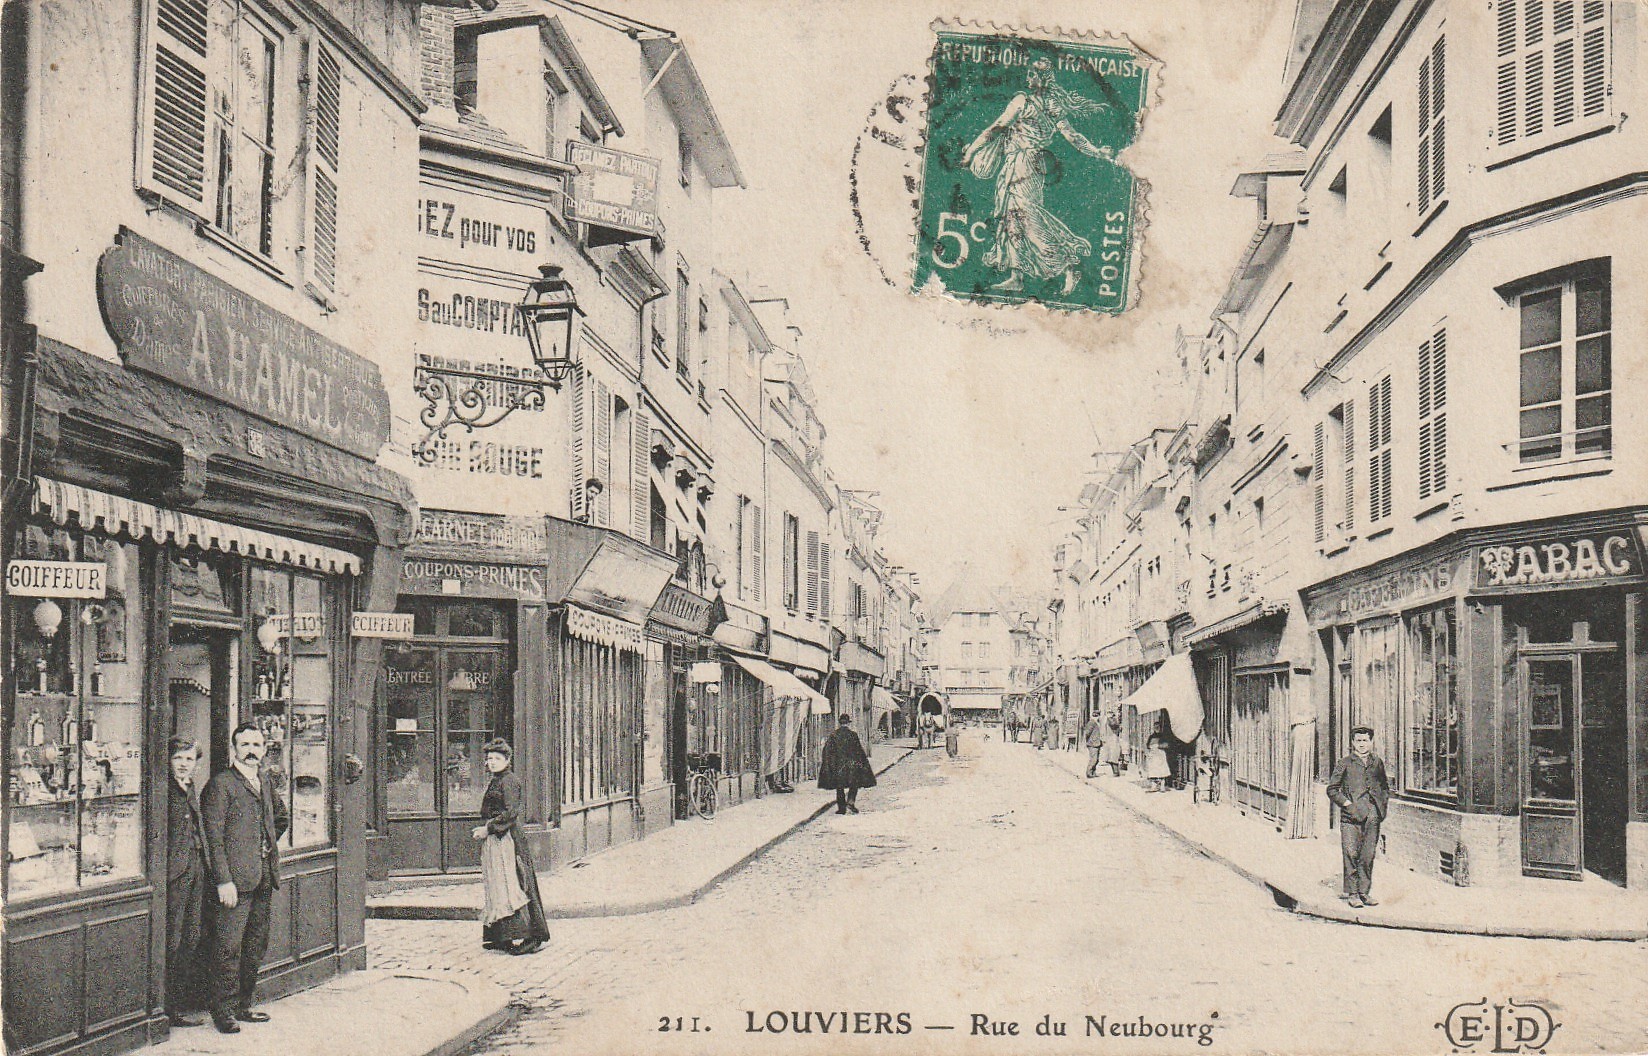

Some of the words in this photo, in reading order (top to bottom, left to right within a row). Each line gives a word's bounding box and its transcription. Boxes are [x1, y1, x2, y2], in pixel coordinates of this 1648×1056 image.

[1057, 52, 1139, 78] FRANÇAISE
[461, 217, 501, 248] pour
[1097, 210, 1124, 297] POSTES
[469, 440, 543, 478] ROUGE
[1479, 535, 1631, 585] TABAC
[9, 564, 101, 591] COIFFEUR
